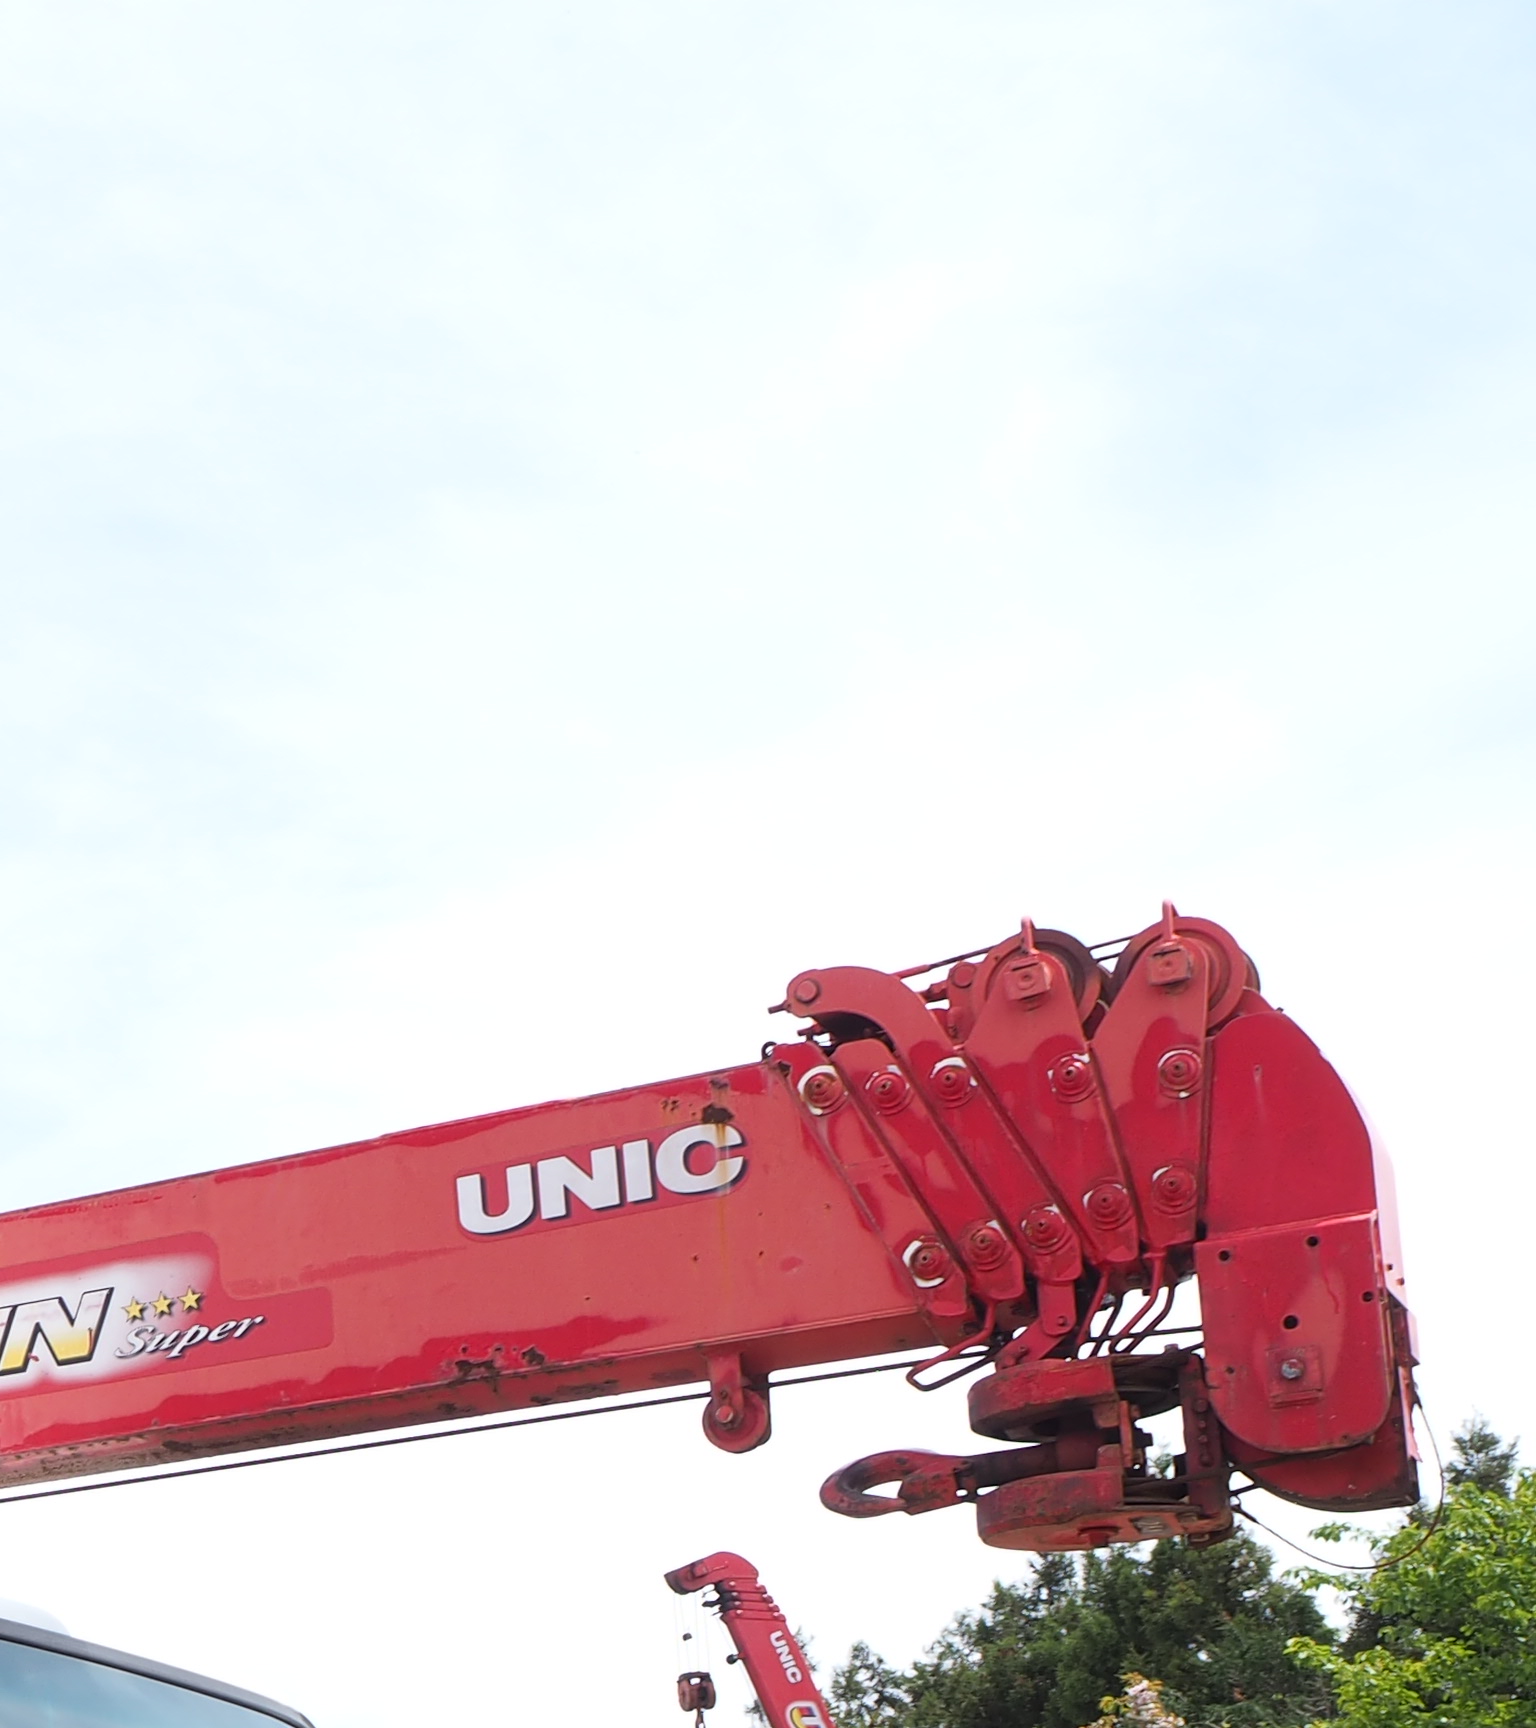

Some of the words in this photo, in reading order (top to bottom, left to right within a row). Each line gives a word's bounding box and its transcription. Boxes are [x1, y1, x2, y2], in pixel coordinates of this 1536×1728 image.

[456, 1124, 746, 1235] UNIC
[117, 1311, 266, 1360] Super
[769, 1630, 803, 1684] UNIC
